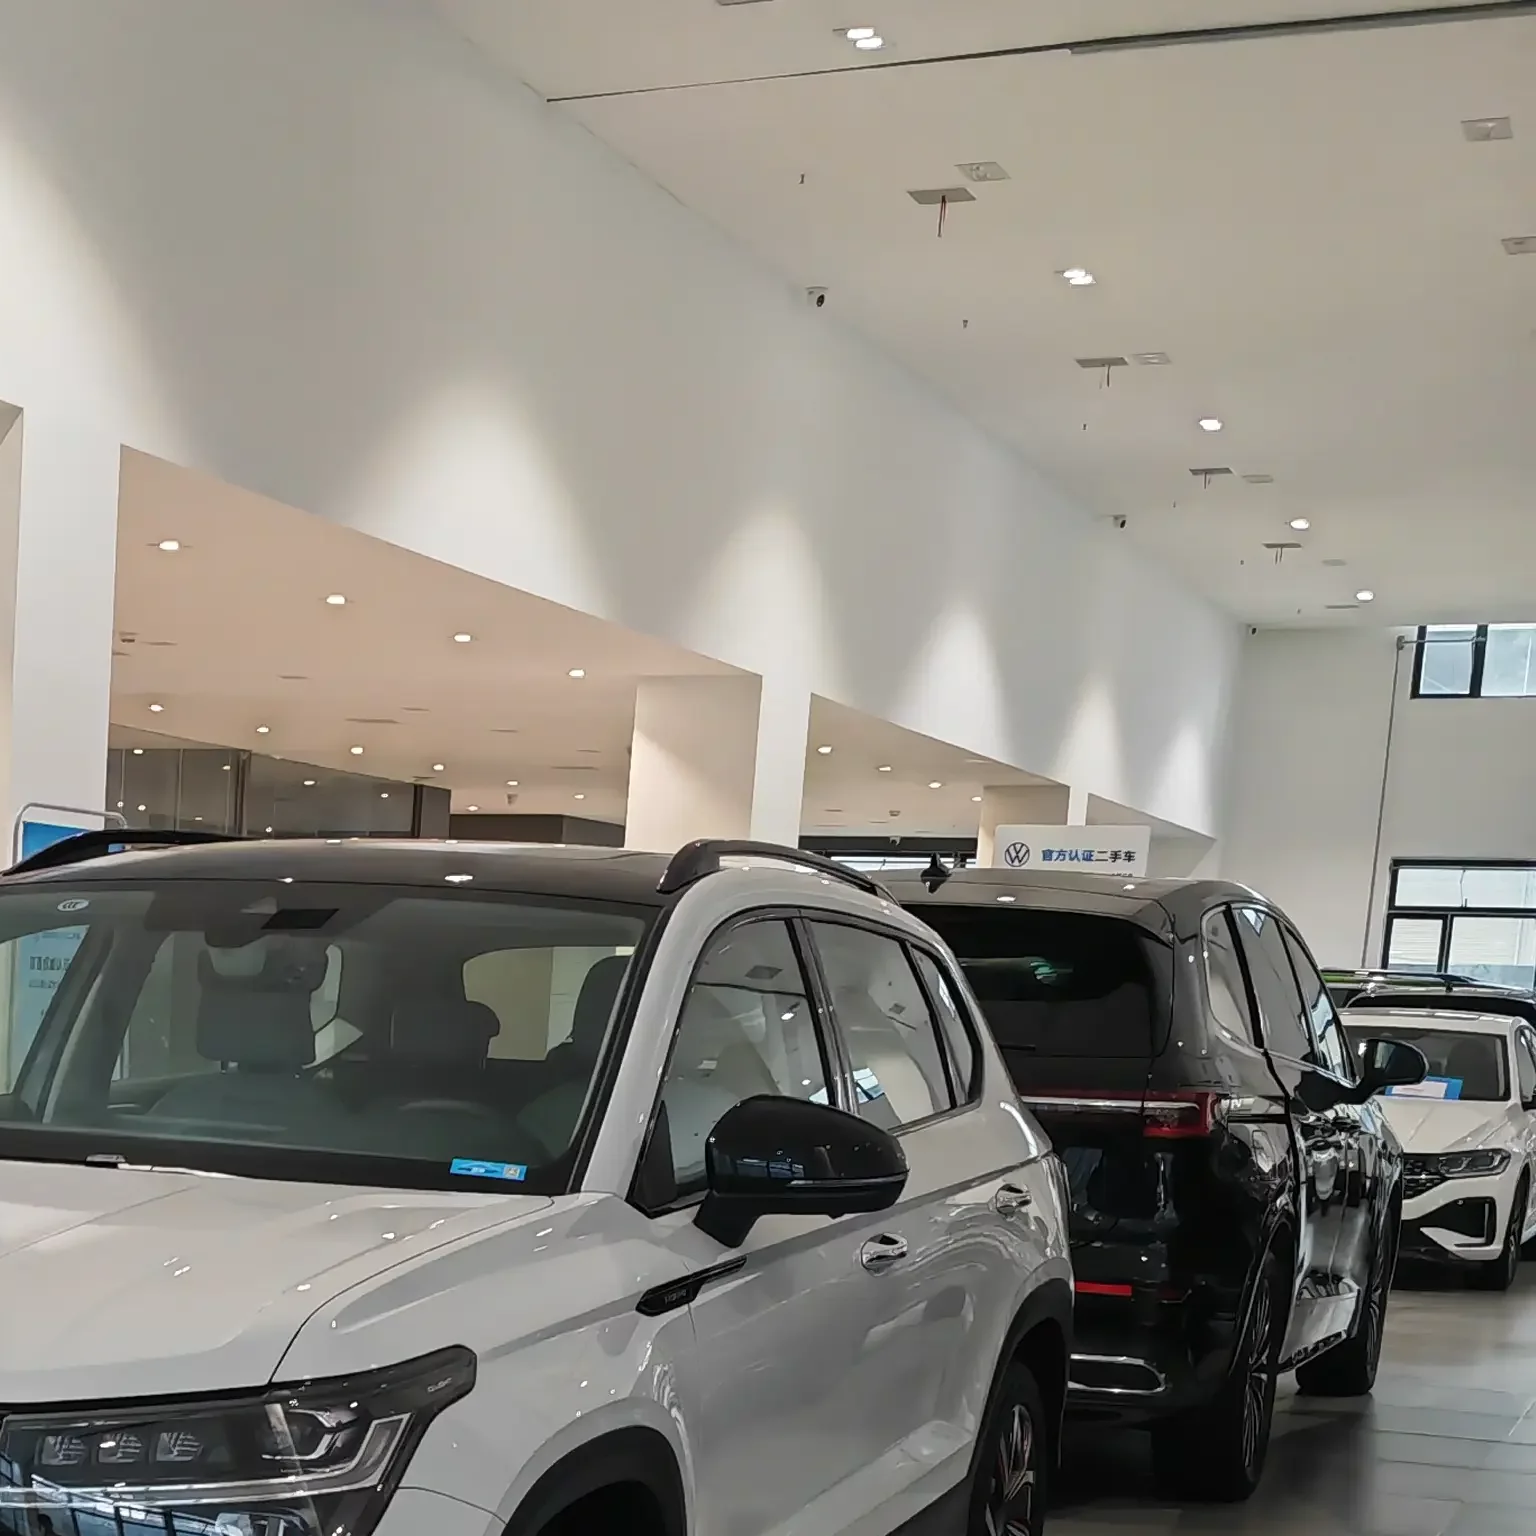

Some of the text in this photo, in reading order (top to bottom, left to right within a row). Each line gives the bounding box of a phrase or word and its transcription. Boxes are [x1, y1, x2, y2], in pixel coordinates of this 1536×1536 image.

[1042, 849, 1136, 863] 官方认证二手车
